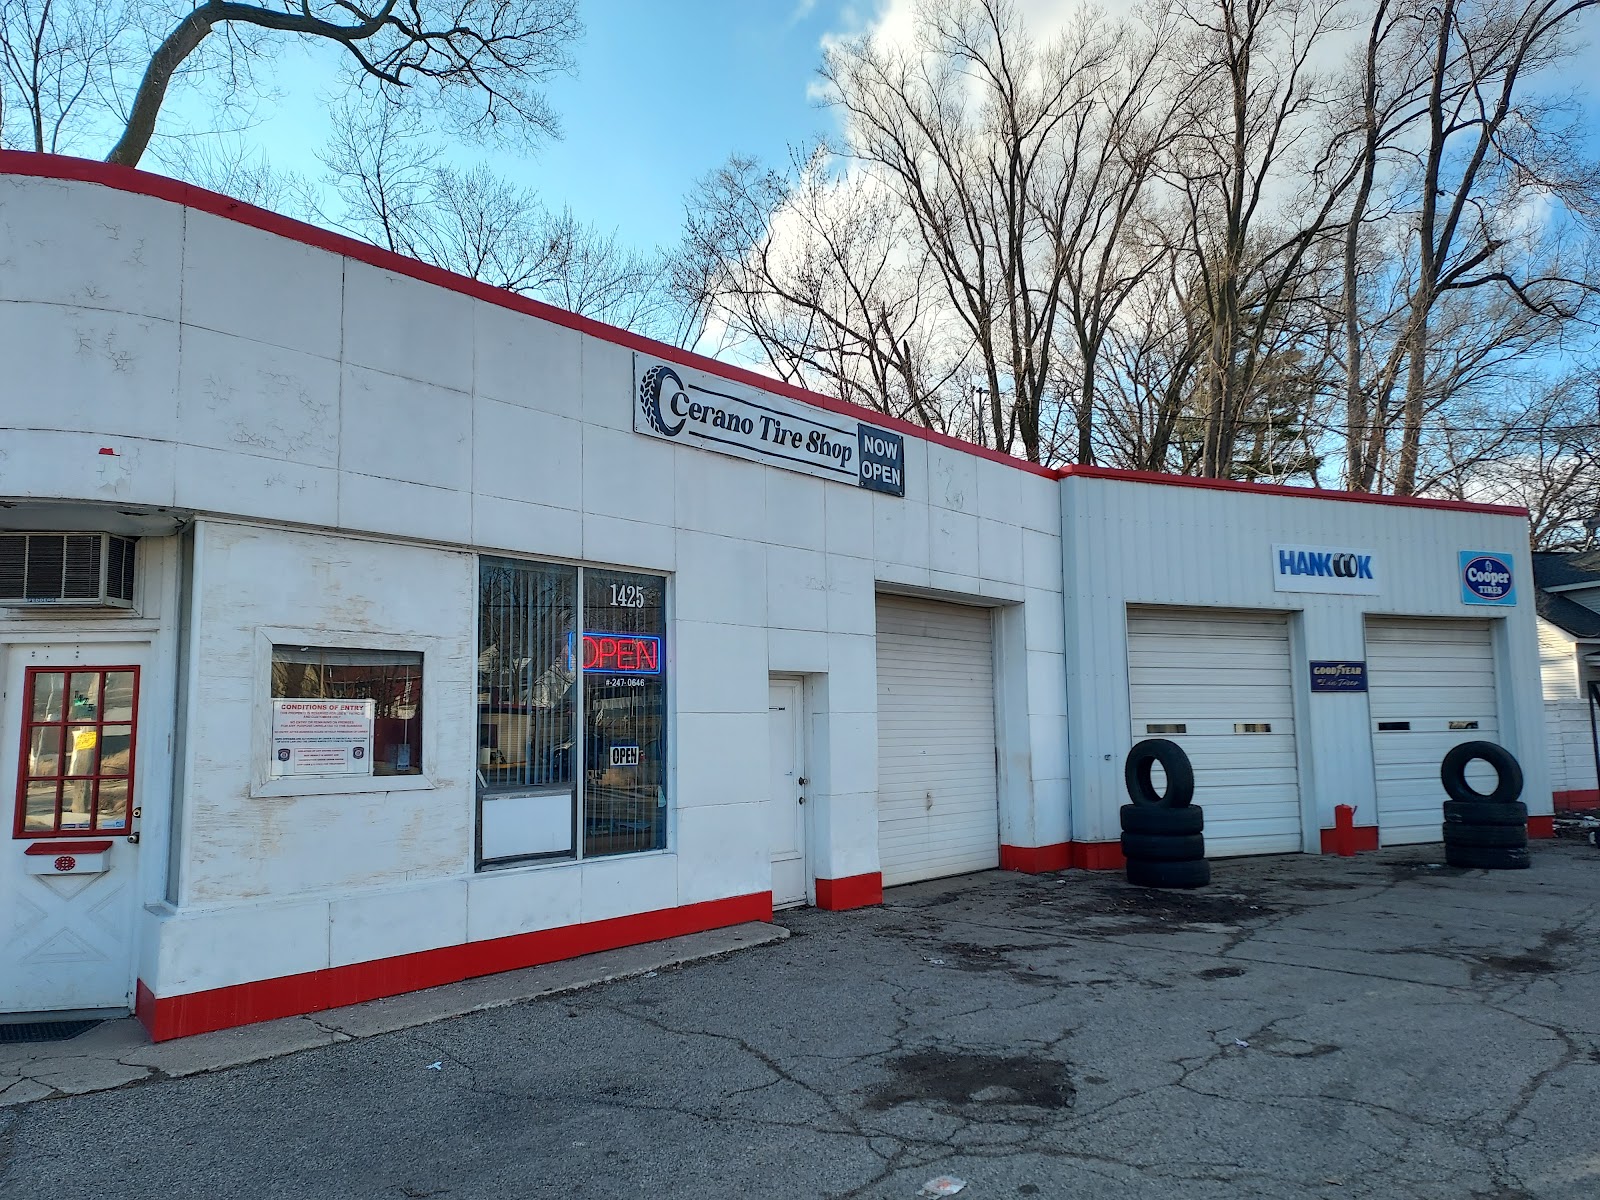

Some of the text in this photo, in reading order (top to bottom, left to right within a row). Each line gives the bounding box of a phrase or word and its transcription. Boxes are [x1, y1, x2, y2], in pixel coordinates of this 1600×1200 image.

[670, 391, 853, 468] Cerano Tire Shop
[864, 435, 898, 460] NOW
[861, 460, 901, 486] OPEN
[1279, 549, 1374, 579] HANKOOK
[1467, 567, 1510, 586] Cooper
[610, 583, 645, 609] 1425
[1478, 585, 1503, 595] TIRES
[582, 636, 658, 670] OPEN
[1313, 664, 1362, 677] GOODYEAR
[612, 747, 638, 765] OPEN
